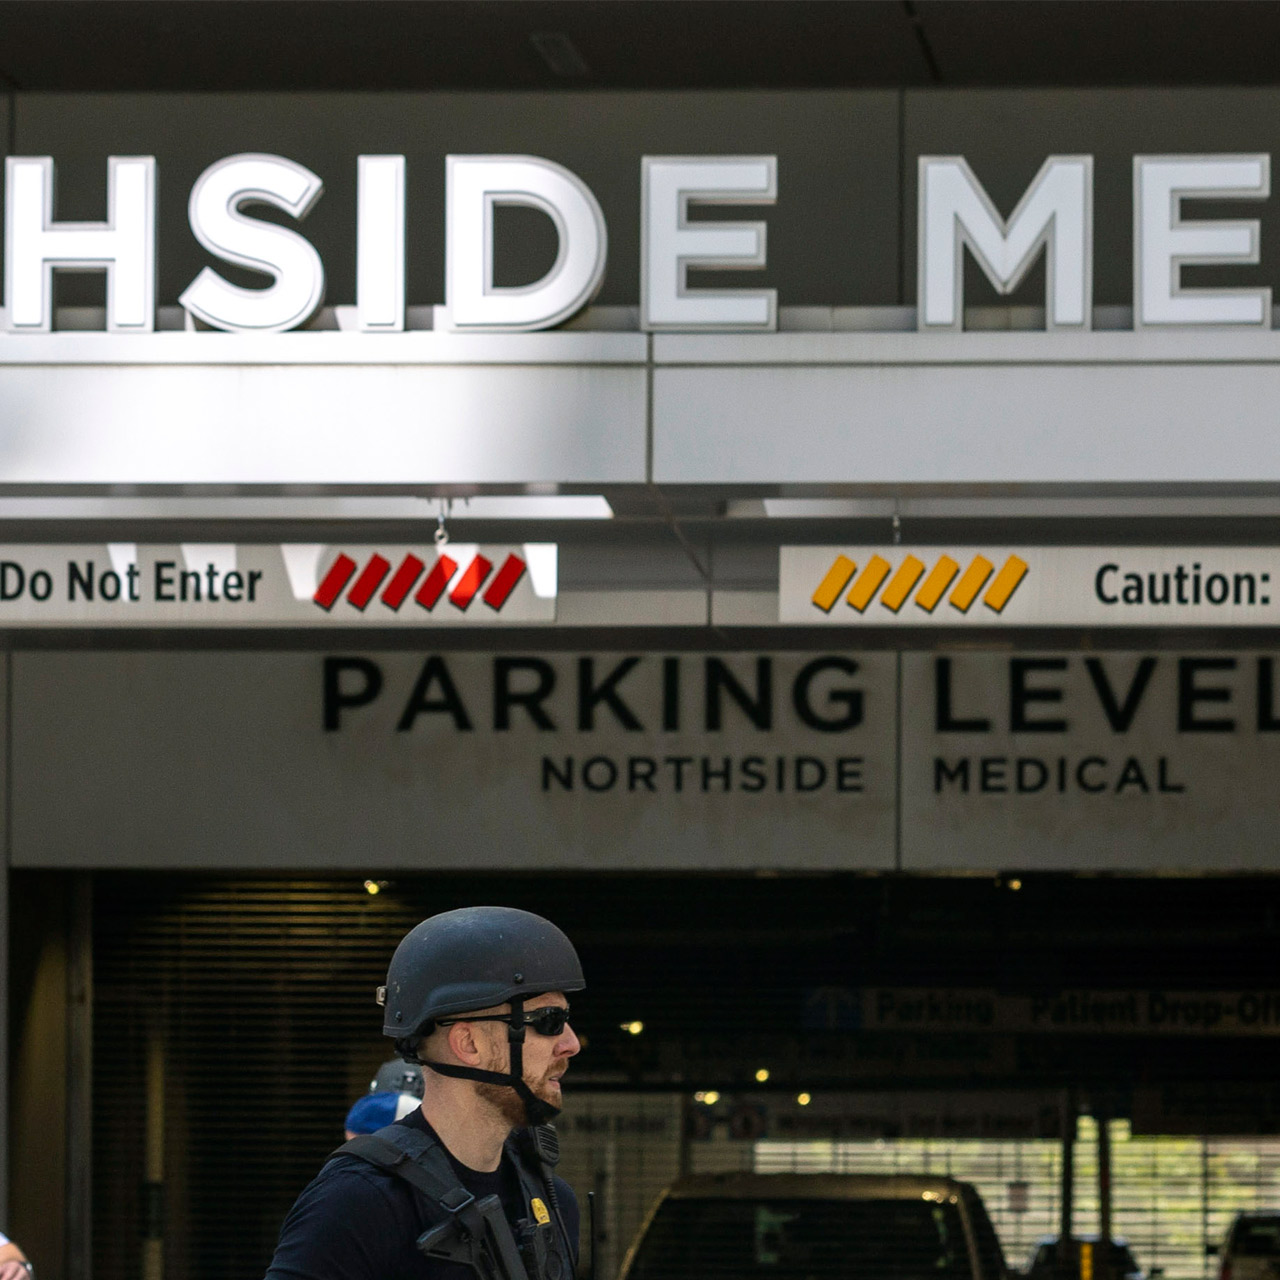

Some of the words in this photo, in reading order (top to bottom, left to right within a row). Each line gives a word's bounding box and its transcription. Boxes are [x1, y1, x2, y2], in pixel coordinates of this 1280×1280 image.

[0, 560, 52, 601] Do
[68, 560, 140, 601] Not
[155, 560, 262, 601] Enter
[1094, 562, 1271, 606] Caution:
[321, 655, 867, 735] PARKING
[541, 755, 866, 793] NORTHSIDE
[933, 755, 1185, 794] MEDICAL
[877, 992, 992, 1026] Parking
[1030, 992, 1140, 1023] Patient
